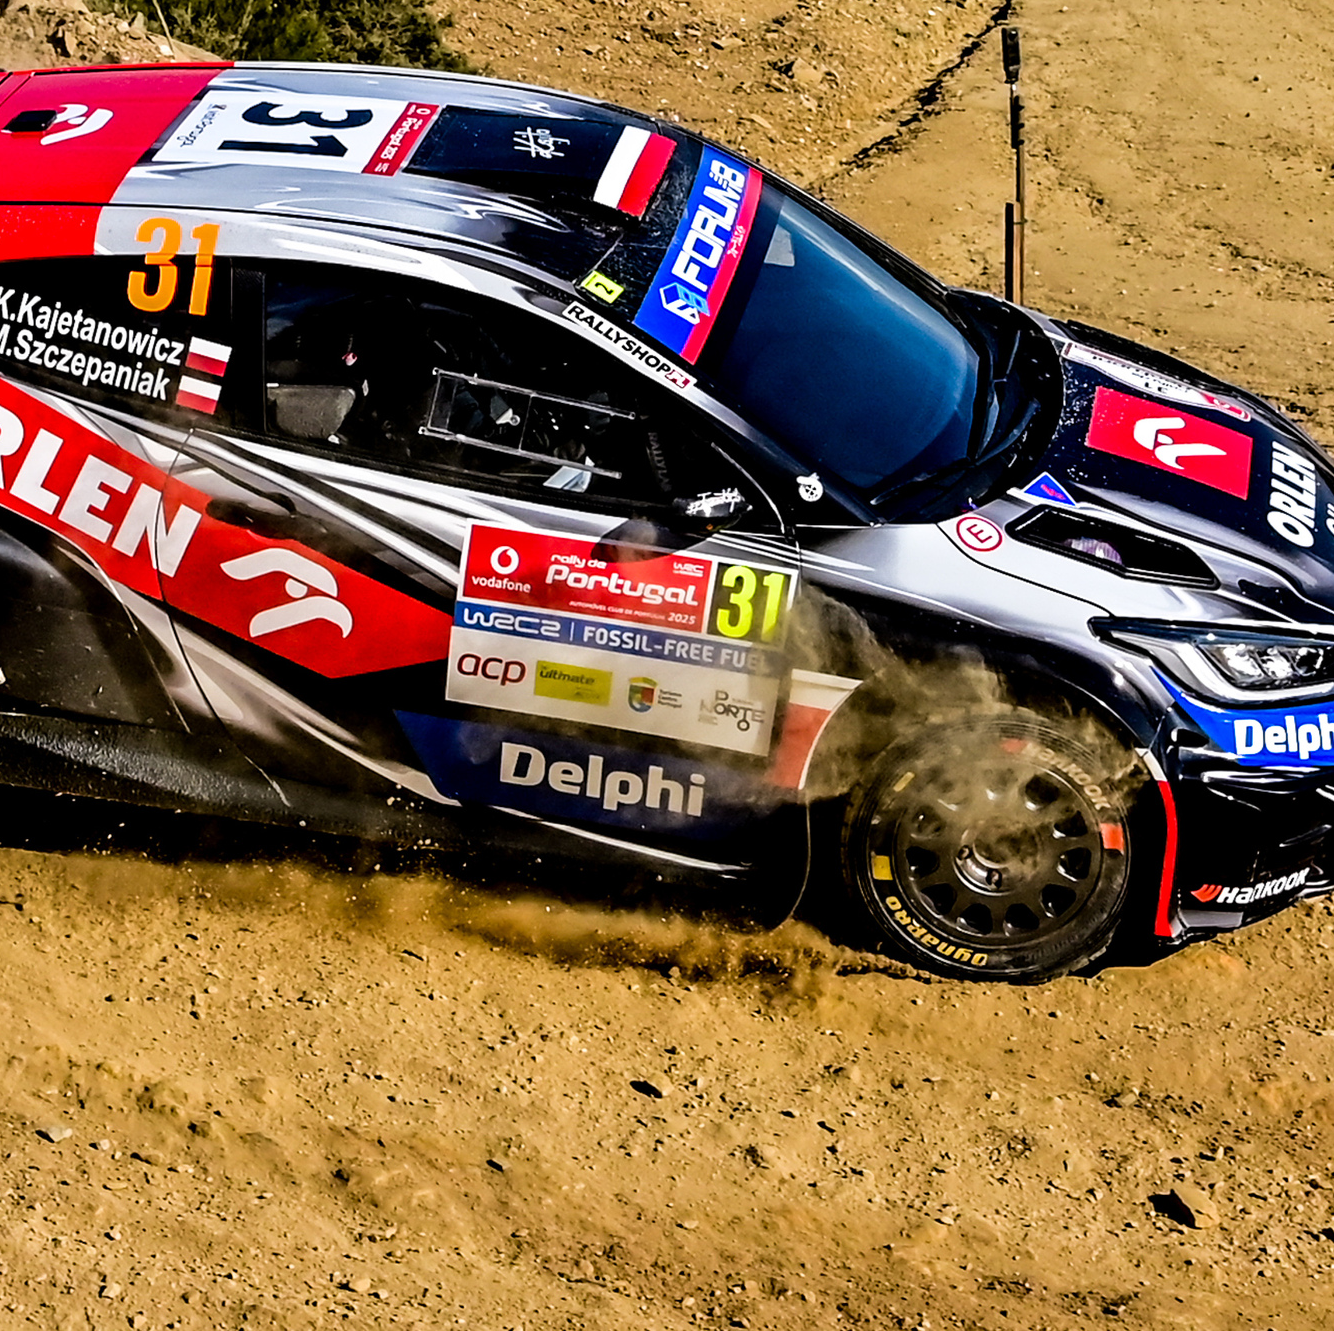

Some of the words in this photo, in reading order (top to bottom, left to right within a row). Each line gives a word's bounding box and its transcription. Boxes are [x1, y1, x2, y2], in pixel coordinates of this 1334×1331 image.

[217, 101, 374, 158] 31
[127, 217, 221, 317] 31
[1267, 441, 1316, 548] ORLEN
[965, 523, 993, 544] E
[471, 575, 532, 594] vodafone
[545, 563, 699, 606] Portugal
[550, 553, 587, 569] rally
[587, 559, 608, 570] de
[667, 612, 697, 626] 2025
[716, 564, 785, 643] 31
[463, 608, 562, 638] WRC2
[583, 625, 714, 663] FOSSIL-FREE
[457, 652, 528, 687] acp
[499, 741, 707, 819] Delphi
